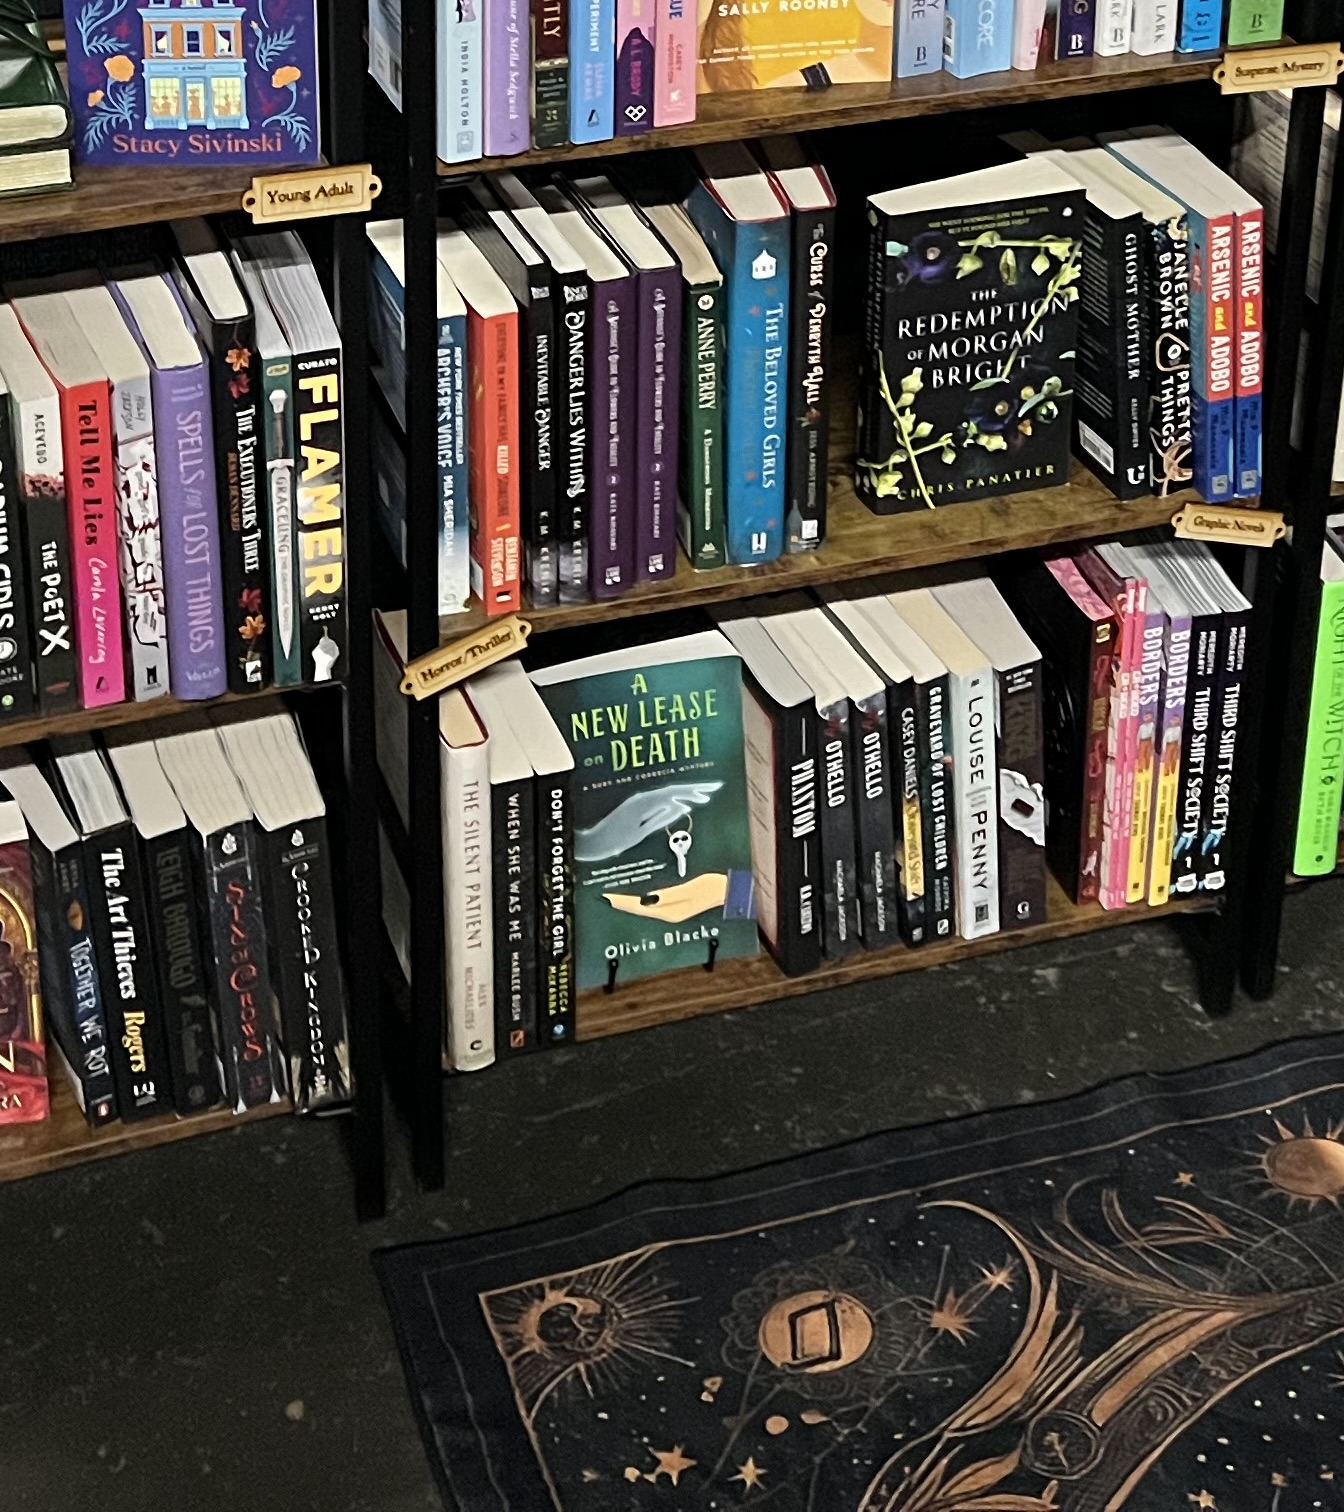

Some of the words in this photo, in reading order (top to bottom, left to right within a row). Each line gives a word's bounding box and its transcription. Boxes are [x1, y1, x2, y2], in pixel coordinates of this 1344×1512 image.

[718, 0, 770, 17] SALLY
[112, 134, 181, 156] Stacy
[188, 132, 283, 153] Sivinski
[266, 188, 310, 204] Young
[315, 180, 354, 199] Adult
[1209, 224, 1231, 303] ARSENIC
[1240, 220, 1261, 299] ARSENIC
[763, 302, 784, 341] THE
[897, 296, 1069, 339] REDEMPTION
[1213, 306, 1227, 331] and
[1243, 301, 1257, 327] and
[928, 324, 1046, 362] MORGAN
[1209, 335, 1231, 394] ADOBO
[1240, 331, 1261, 389] ADOBO
[762, 345, 783, 431] BELOVED
[76, 398, 101, 447] Tell
[81, 454, 103, 493] Me
[298, 372, 343, 598] FLAMER
[761, 434, 781, 490] GIRLS
[82, 496, 104, 547] Lies
[420, 627, 514, 683] Horror/Thriller
[1139, 625, 1164, 708] BORDERS
[1164, 629, 1191, 710] BORDERS
[631, 672, 648, 694] A
[1222, 682, 1241, 729] THIRD
[571, 704, 629, 742] NEW
[639, 688, 719, 726] LEASE
[967, 695, 986, 786] LOUISE
[584, 752, 604, 767] on
[610, 726, 702, 773] DEATH
[825, 739, 847, 809] OTHELLO
[862, 731, 883, 800] OTHELLO
[1218, 732, 1237, 779] SHIFT
[973, 813, 989, 892] PENNY
[604, 936, 657, 960] Olivia
[664, 925, 720, 946] Blacke
